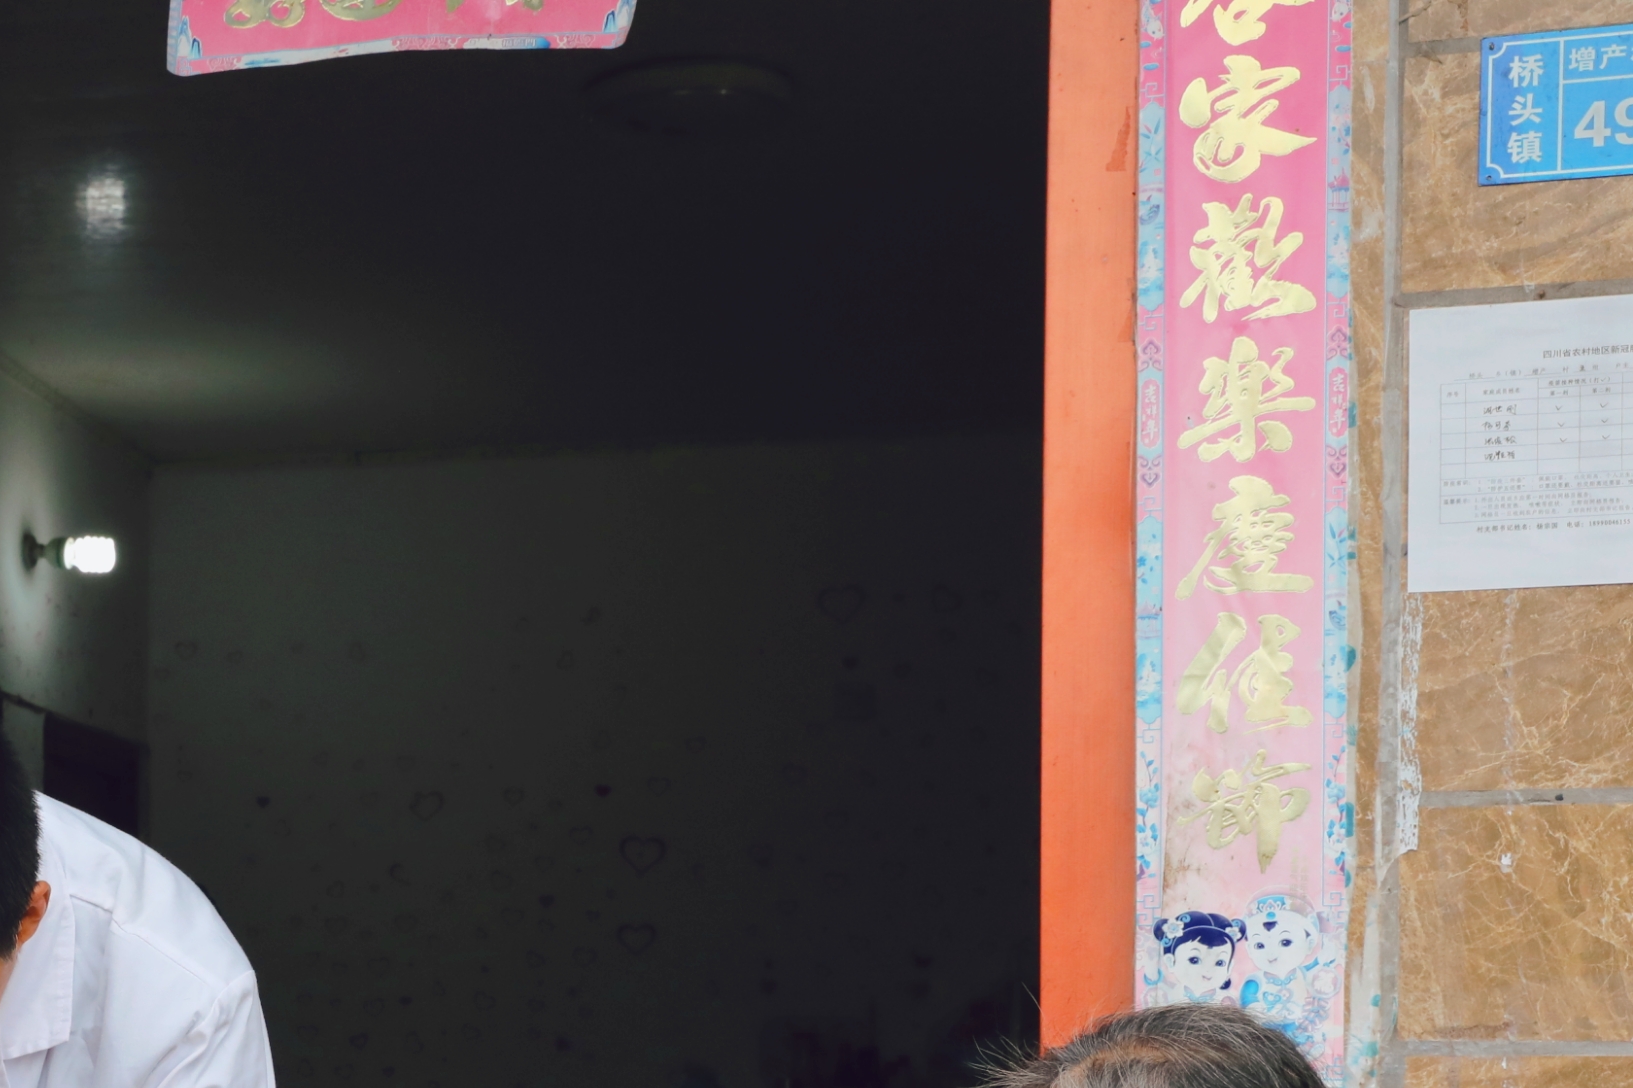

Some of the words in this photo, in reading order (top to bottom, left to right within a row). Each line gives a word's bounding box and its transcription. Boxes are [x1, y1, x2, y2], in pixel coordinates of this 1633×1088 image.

[1568, 44, 1633, 72] 增产
[1507, 54, 1544, 163] 桥头镇
